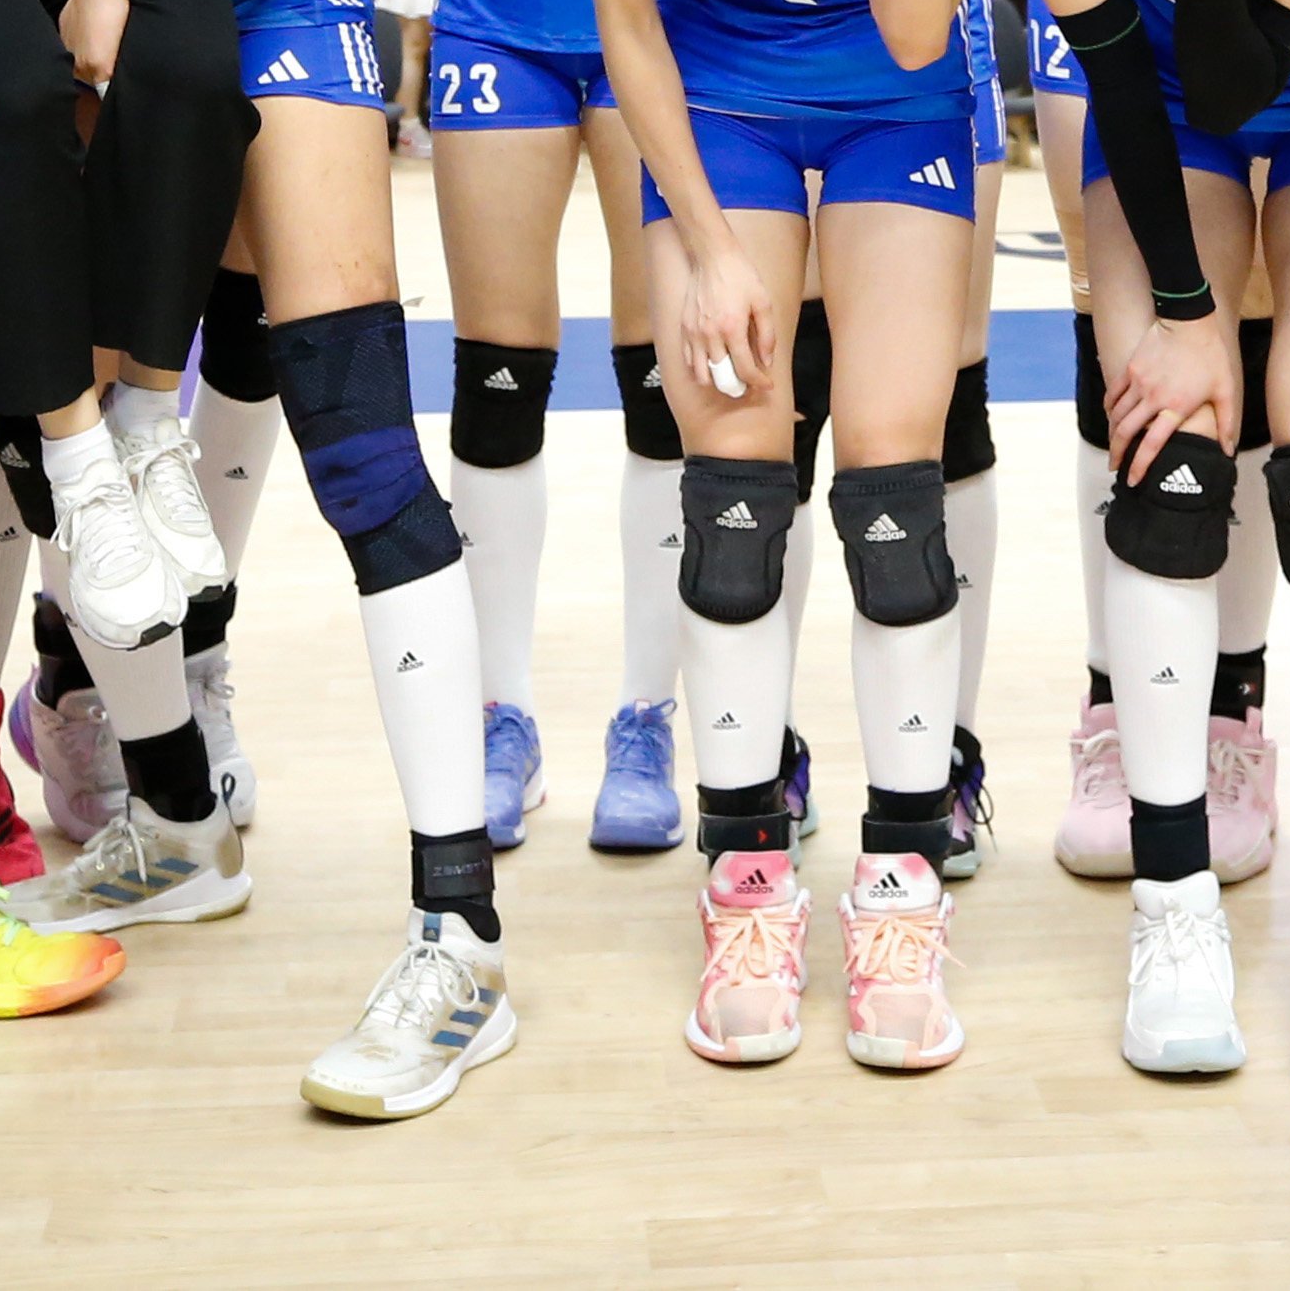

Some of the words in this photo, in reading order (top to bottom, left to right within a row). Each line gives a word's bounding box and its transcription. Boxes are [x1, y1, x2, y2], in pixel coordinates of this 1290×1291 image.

[1030, 18, 1071, 80] 12
[438, 63, 501, 115] 23
[1159, 480, 1203, 495] adidas
[716, 516, 758, 530] adidas
[864, 528, 907, 542] adidas
[734, 885, 774, 895] adidas
[868, 890, 909, 899] adidas
